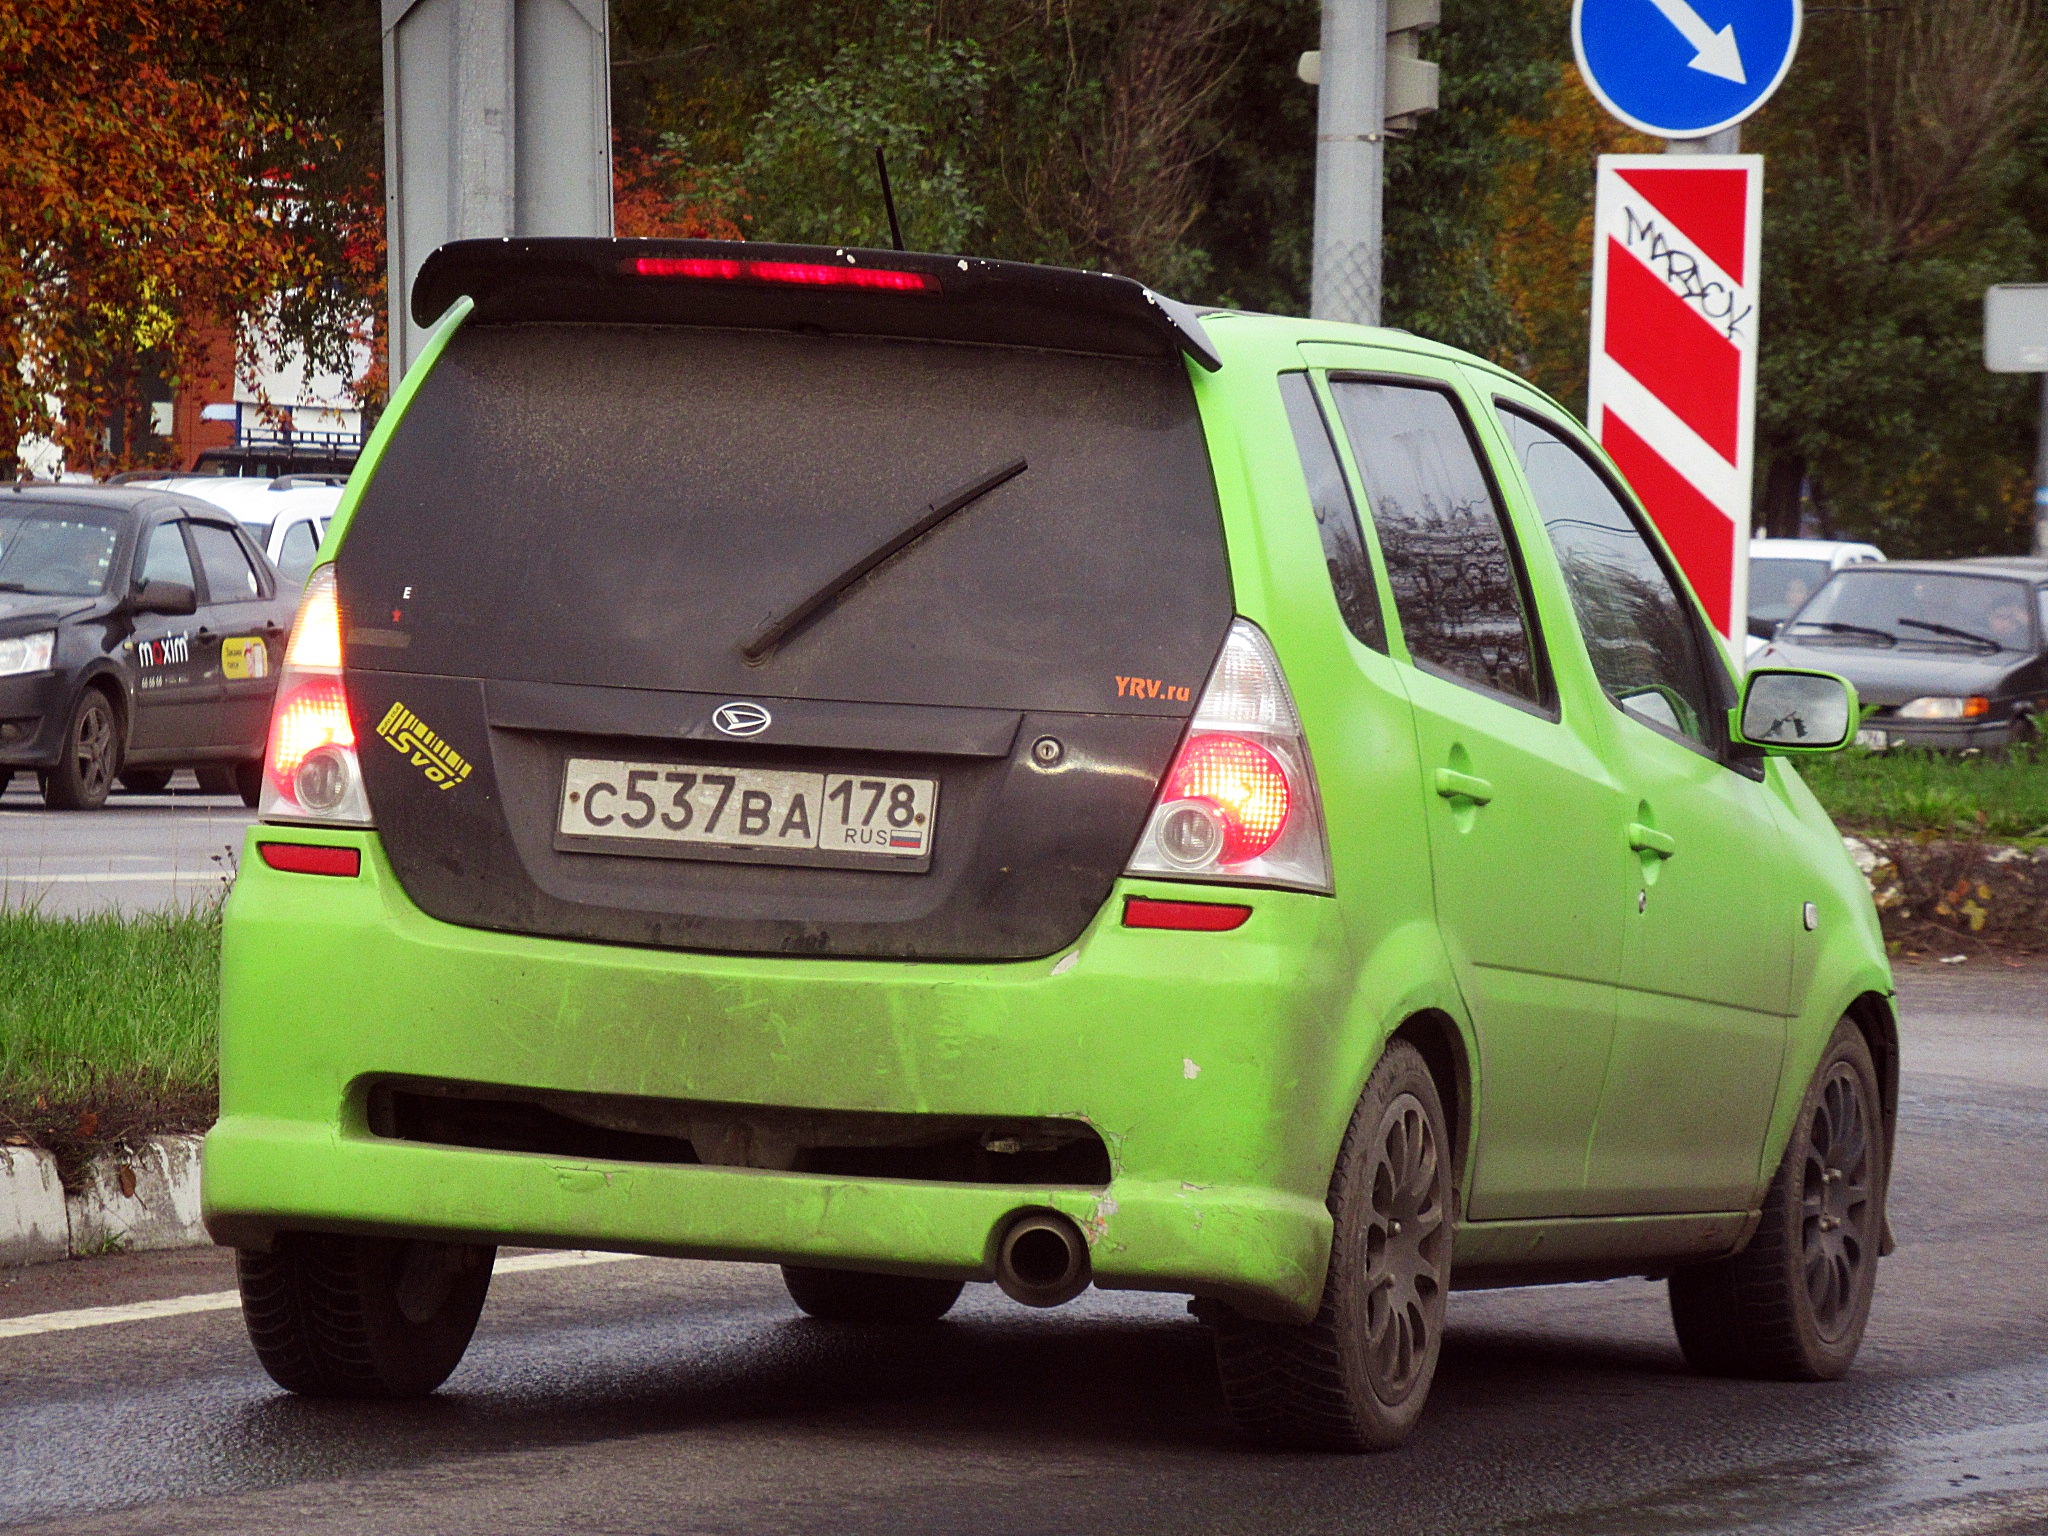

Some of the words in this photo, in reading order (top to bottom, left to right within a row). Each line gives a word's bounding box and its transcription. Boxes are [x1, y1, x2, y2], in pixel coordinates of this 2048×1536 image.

[1115, 675, 1191, 702] YRV.ru
[583, 770, 811, 840] C537BA
[828, 779, 916, 829] 178
[844, 828, 887, 846] RUS
